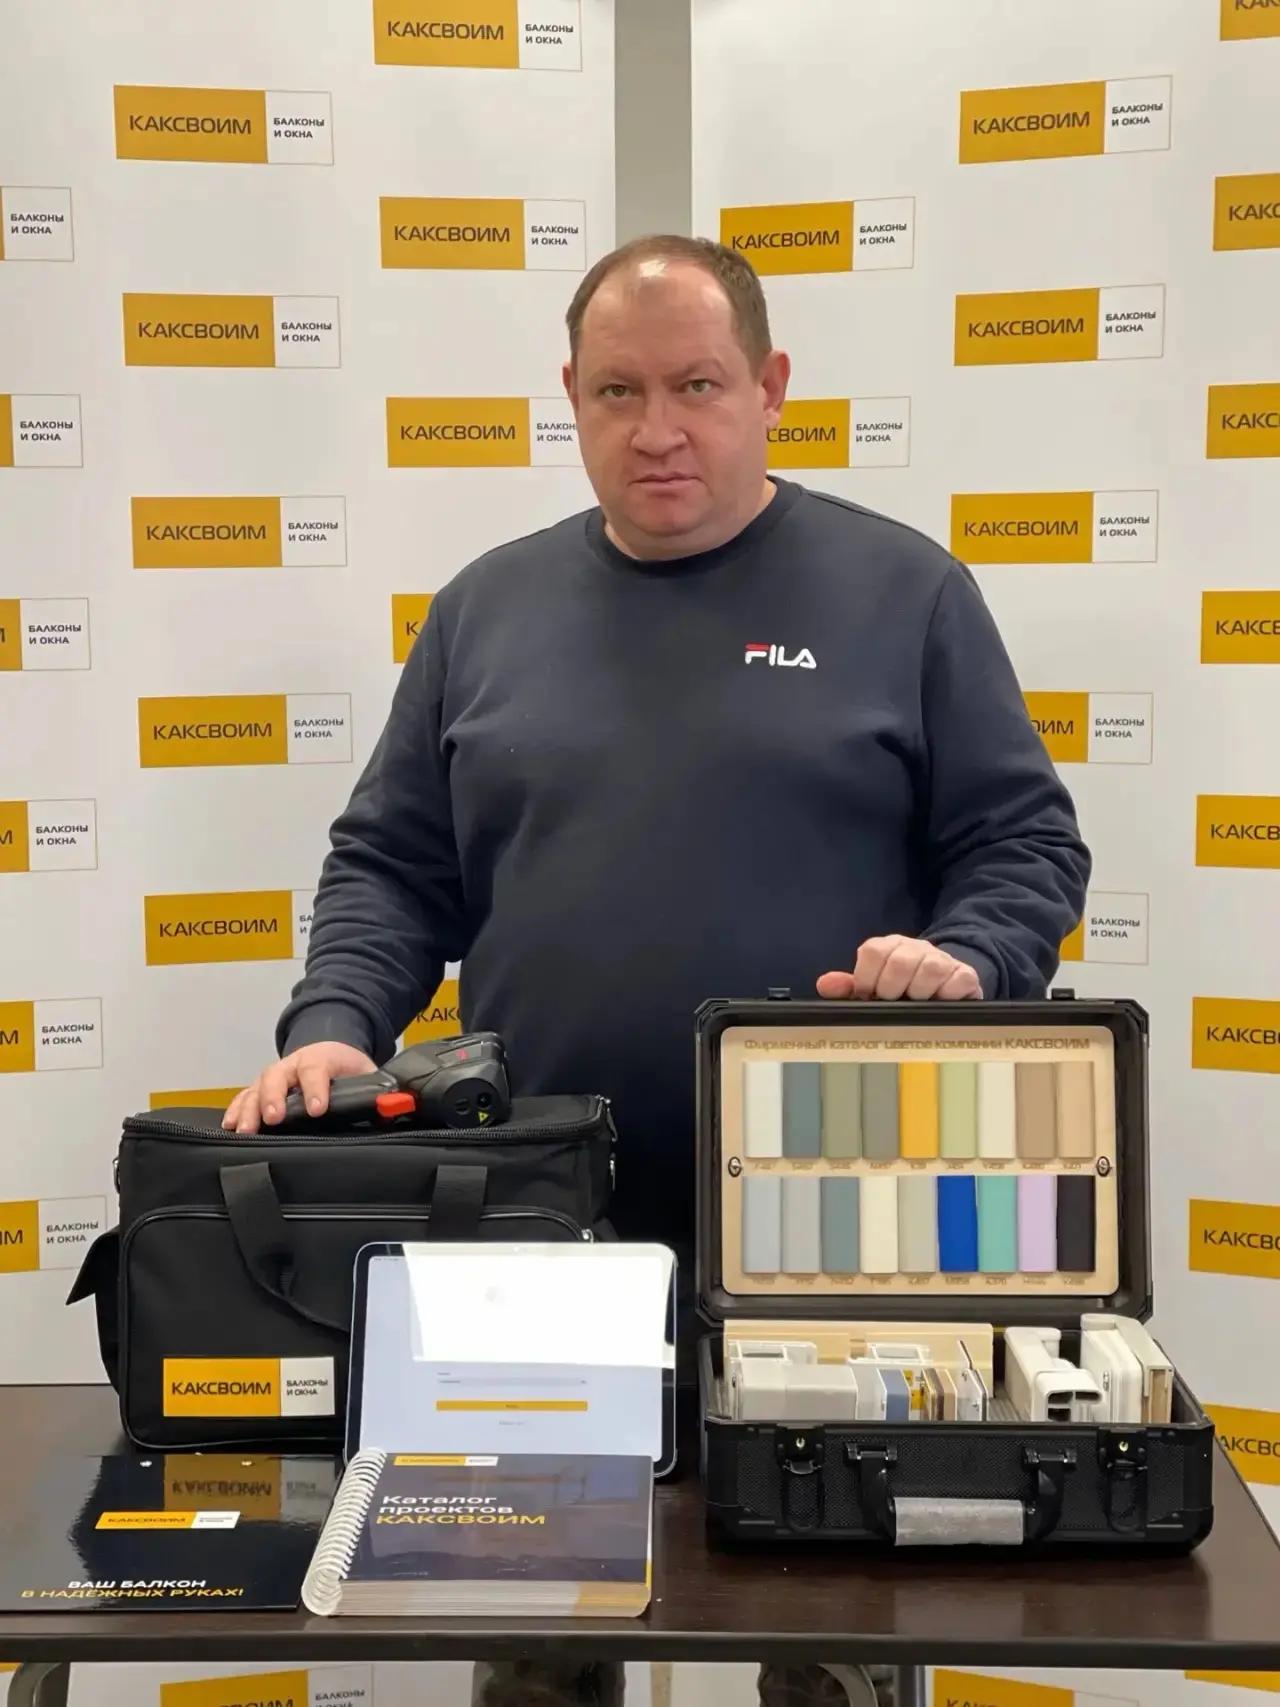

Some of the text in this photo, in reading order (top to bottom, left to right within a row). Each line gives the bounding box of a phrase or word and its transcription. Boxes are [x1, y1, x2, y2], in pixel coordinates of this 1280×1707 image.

[388, 21, 503, 40] КАКСВОИМ
[525, 24, 573, 32] БАЛКОНЫ
[536, 36, 562, 44] ОКНА
[1112, 104, 1163, 114] БАЛКОНЫ
[130, 115, 251, 134] КАКСВОИМ
[274, 118, 324, 126] БАЛКОНЫ
[974, 111, 1089, 134] КАКСВОИМ
[1122, 117, 1150, 126] ОКНА
[284, 130, 313, 138] ОКНА
[11, 214, 64, 222] БАЛКОНЫ
[22, 226, 52, 234] ОКНА
[531, 226, 578, 234] БАЛКОНЫ
[860, 224, 907, 233] БАЛКОНЫ
[395, 226, 509, 242] КАКСВОИМ
[541, 237, 567, 245] ОКНА
[732, 230, 840, 250] КАКСВОИМ
[869, 236, 895, 244] ОКНА
[1106, 312, 1156, 321] БАЛКОНЫ
[139, 322, 259, 339] КАКСВОИМ
[282, 322, 331, 330] БАЛКОНЫ
[969, 318, 1083, 337] КАКСВОИМ
[1115, 325, 1143, 333] ОКНА
[20, 421, 73, 429] БАЛКОНЫ
[856, 423, 902, 431] БАЛКОНЫ
[401, 425, 515, 440] КАКСВОИМ
[766, 427, 835, 442] СВОИМ
[1100, 517, 1149, 525] БАЛКОНЫ
[147, 525, 266, 540] КАКСВОИМ
[965, 520, 1078, 536] КАКСВОИМ
[744, 642, 817, 669] FILA
[154, 723, 272, 740] КАКСВОИМ
[305, 730, 332, 738] ОКНА
[36, 825, 88, 833] БАЛКОНЫ
[47, 837, 76, 845] ОКНА
[1091, 918, 1140, 927] БАЛКОНЫ
[160, 919, 277, 937] КАКСВОИМ
[1101, 930, 1128, 938] ОКНА
[42, 1024, 94, 1033] БАЛКОНЫ
[53, 1036, 82, 1044] ОКНА
[1004, 1037, 1090, 1050] КАКСВОИМ
[47, 1222, 98, 1232] БАЛКОНЫ
[57, 1235, 86, 1243] ОКНА
[172, 1380, 270, 1396] КАКСВОИМ
[286, 1379, 328, 1388] БАЛКОНЫ
[286, 1388, 318, 1396] И ОКНА
[1220, 1435, 1280, 1457] АКСВ
[383, 1495, 497, 1505] Каталог
[379, 1506, 514, 1515] проектов
[376, 1515, 545, 1525] КАКСВОИМ
[67, 1580, 206, 1589] ВАШ БАЛКОН
[21, 1590, 35, 1599] В
[169, 1587, 244, 1598] РУКАХ!
